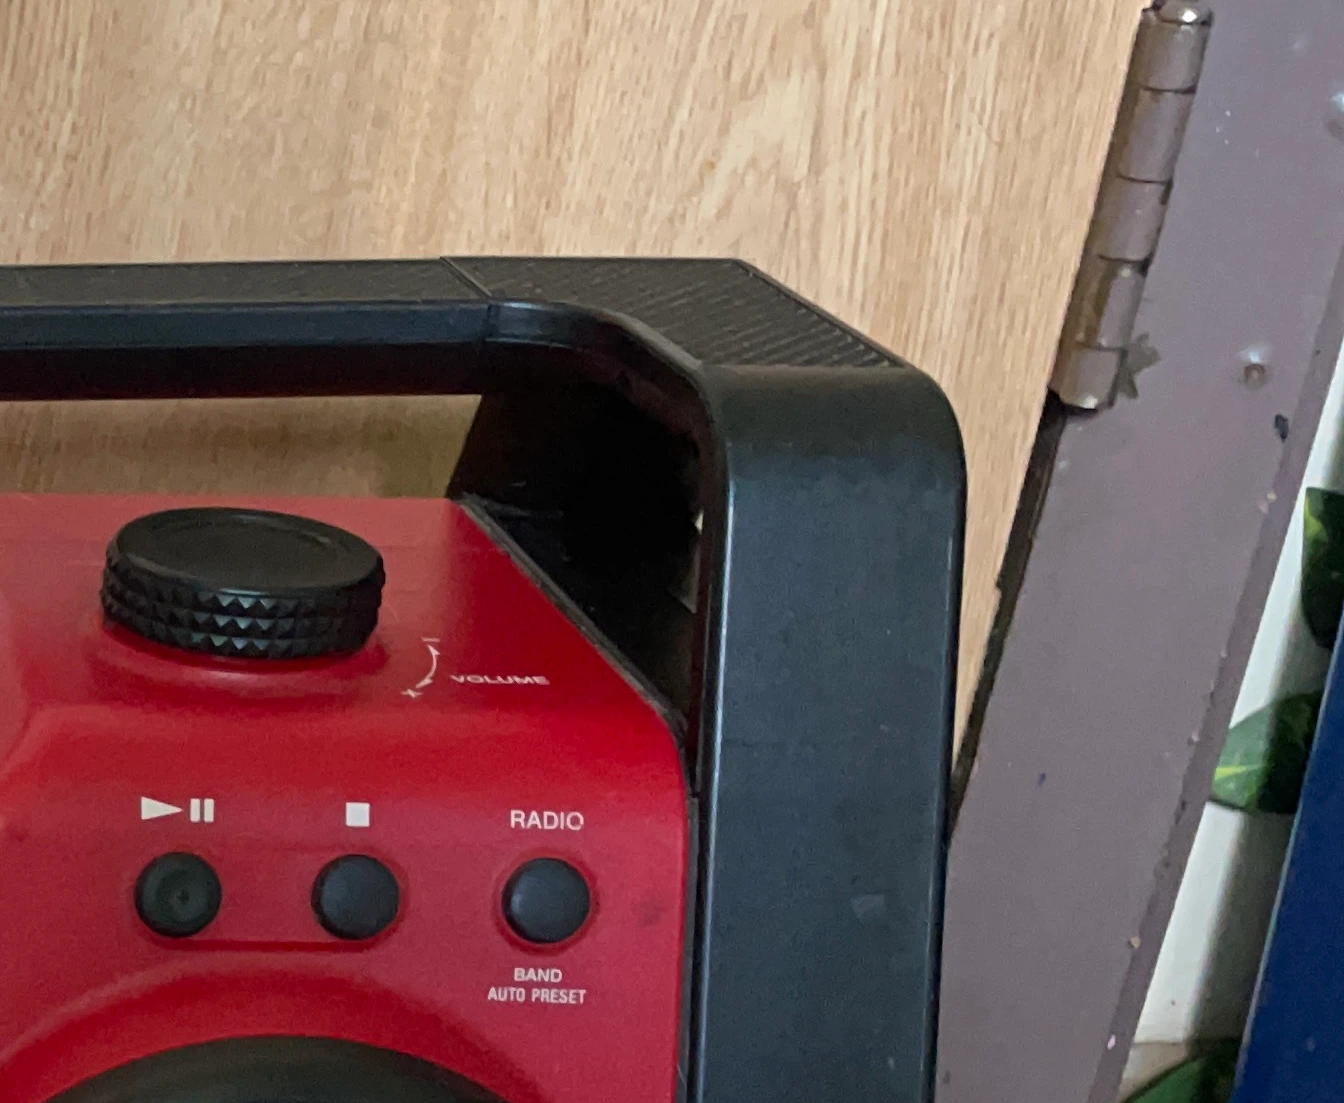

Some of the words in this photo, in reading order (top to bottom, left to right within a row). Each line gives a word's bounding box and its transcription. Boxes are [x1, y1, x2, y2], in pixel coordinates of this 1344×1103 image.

[450, 674, 551, 685] VOLUME
[510, 809, 585, 831] RADIO
[514, 967, 563, 983] BAND
[487, 986, 526, 1002] AUTO
[531, 988, 587, 1005] PRESET
